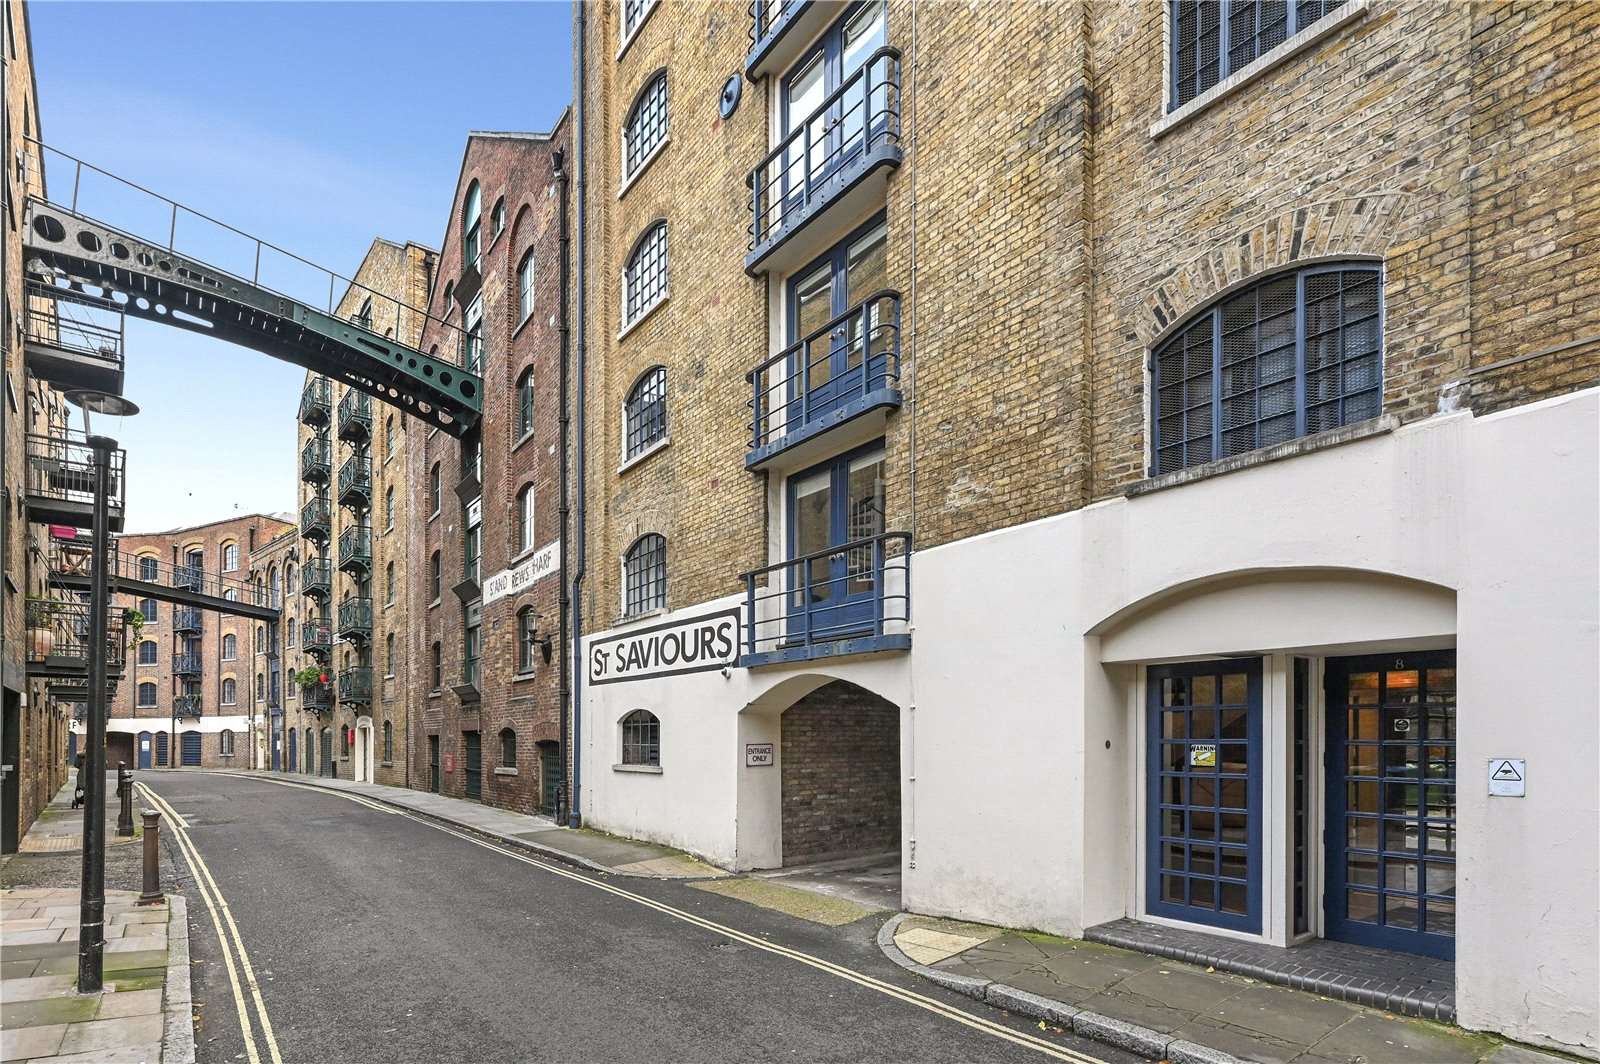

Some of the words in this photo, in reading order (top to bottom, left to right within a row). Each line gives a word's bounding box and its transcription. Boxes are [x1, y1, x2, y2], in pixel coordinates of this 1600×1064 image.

[615, 622, 733, 673] SAVIOURS
[1395, 658, 1405, 670] 8
[748, 747, 771, 755] ENTRANCE
